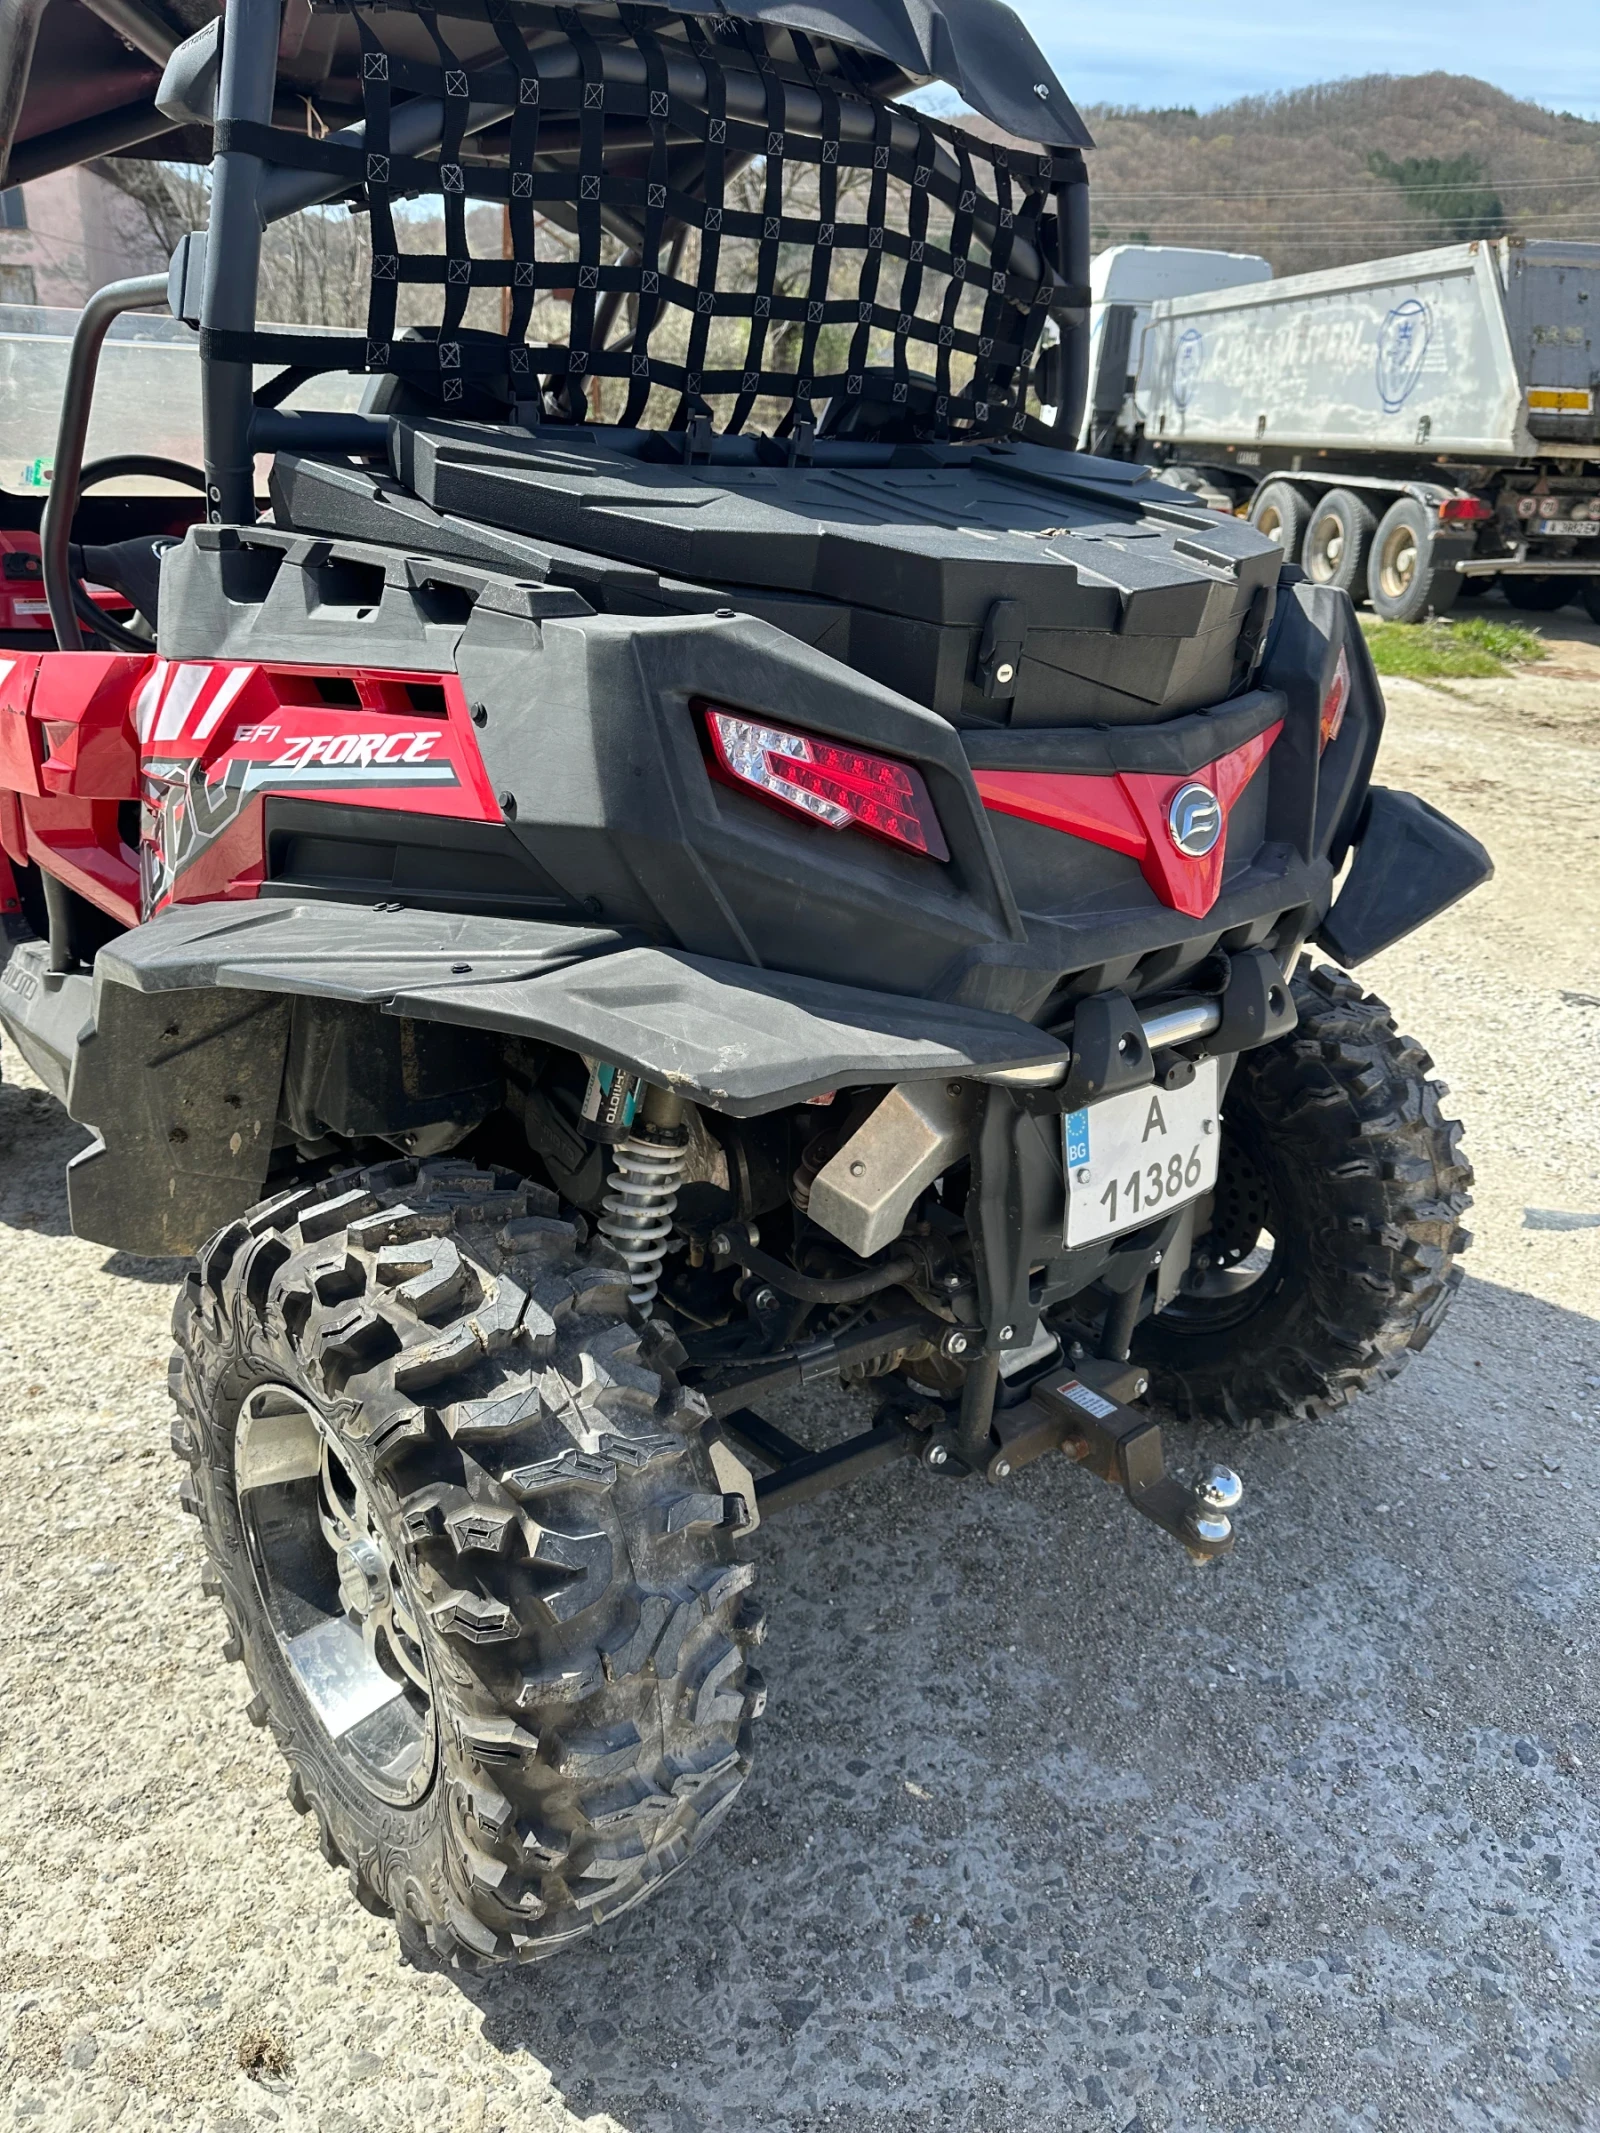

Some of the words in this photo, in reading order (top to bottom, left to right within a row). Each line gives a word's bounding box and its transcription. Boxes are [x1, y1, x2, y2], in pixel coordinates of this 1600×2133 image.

[234, 725, 281, 743] EFI
[268, 732, 443, 777] ZFORCE
[1141, 1095, 1167, 1143] A
[1069, 1142, 1086, 1161] BG
[1100, 1143, 1202, 1223] 11386
